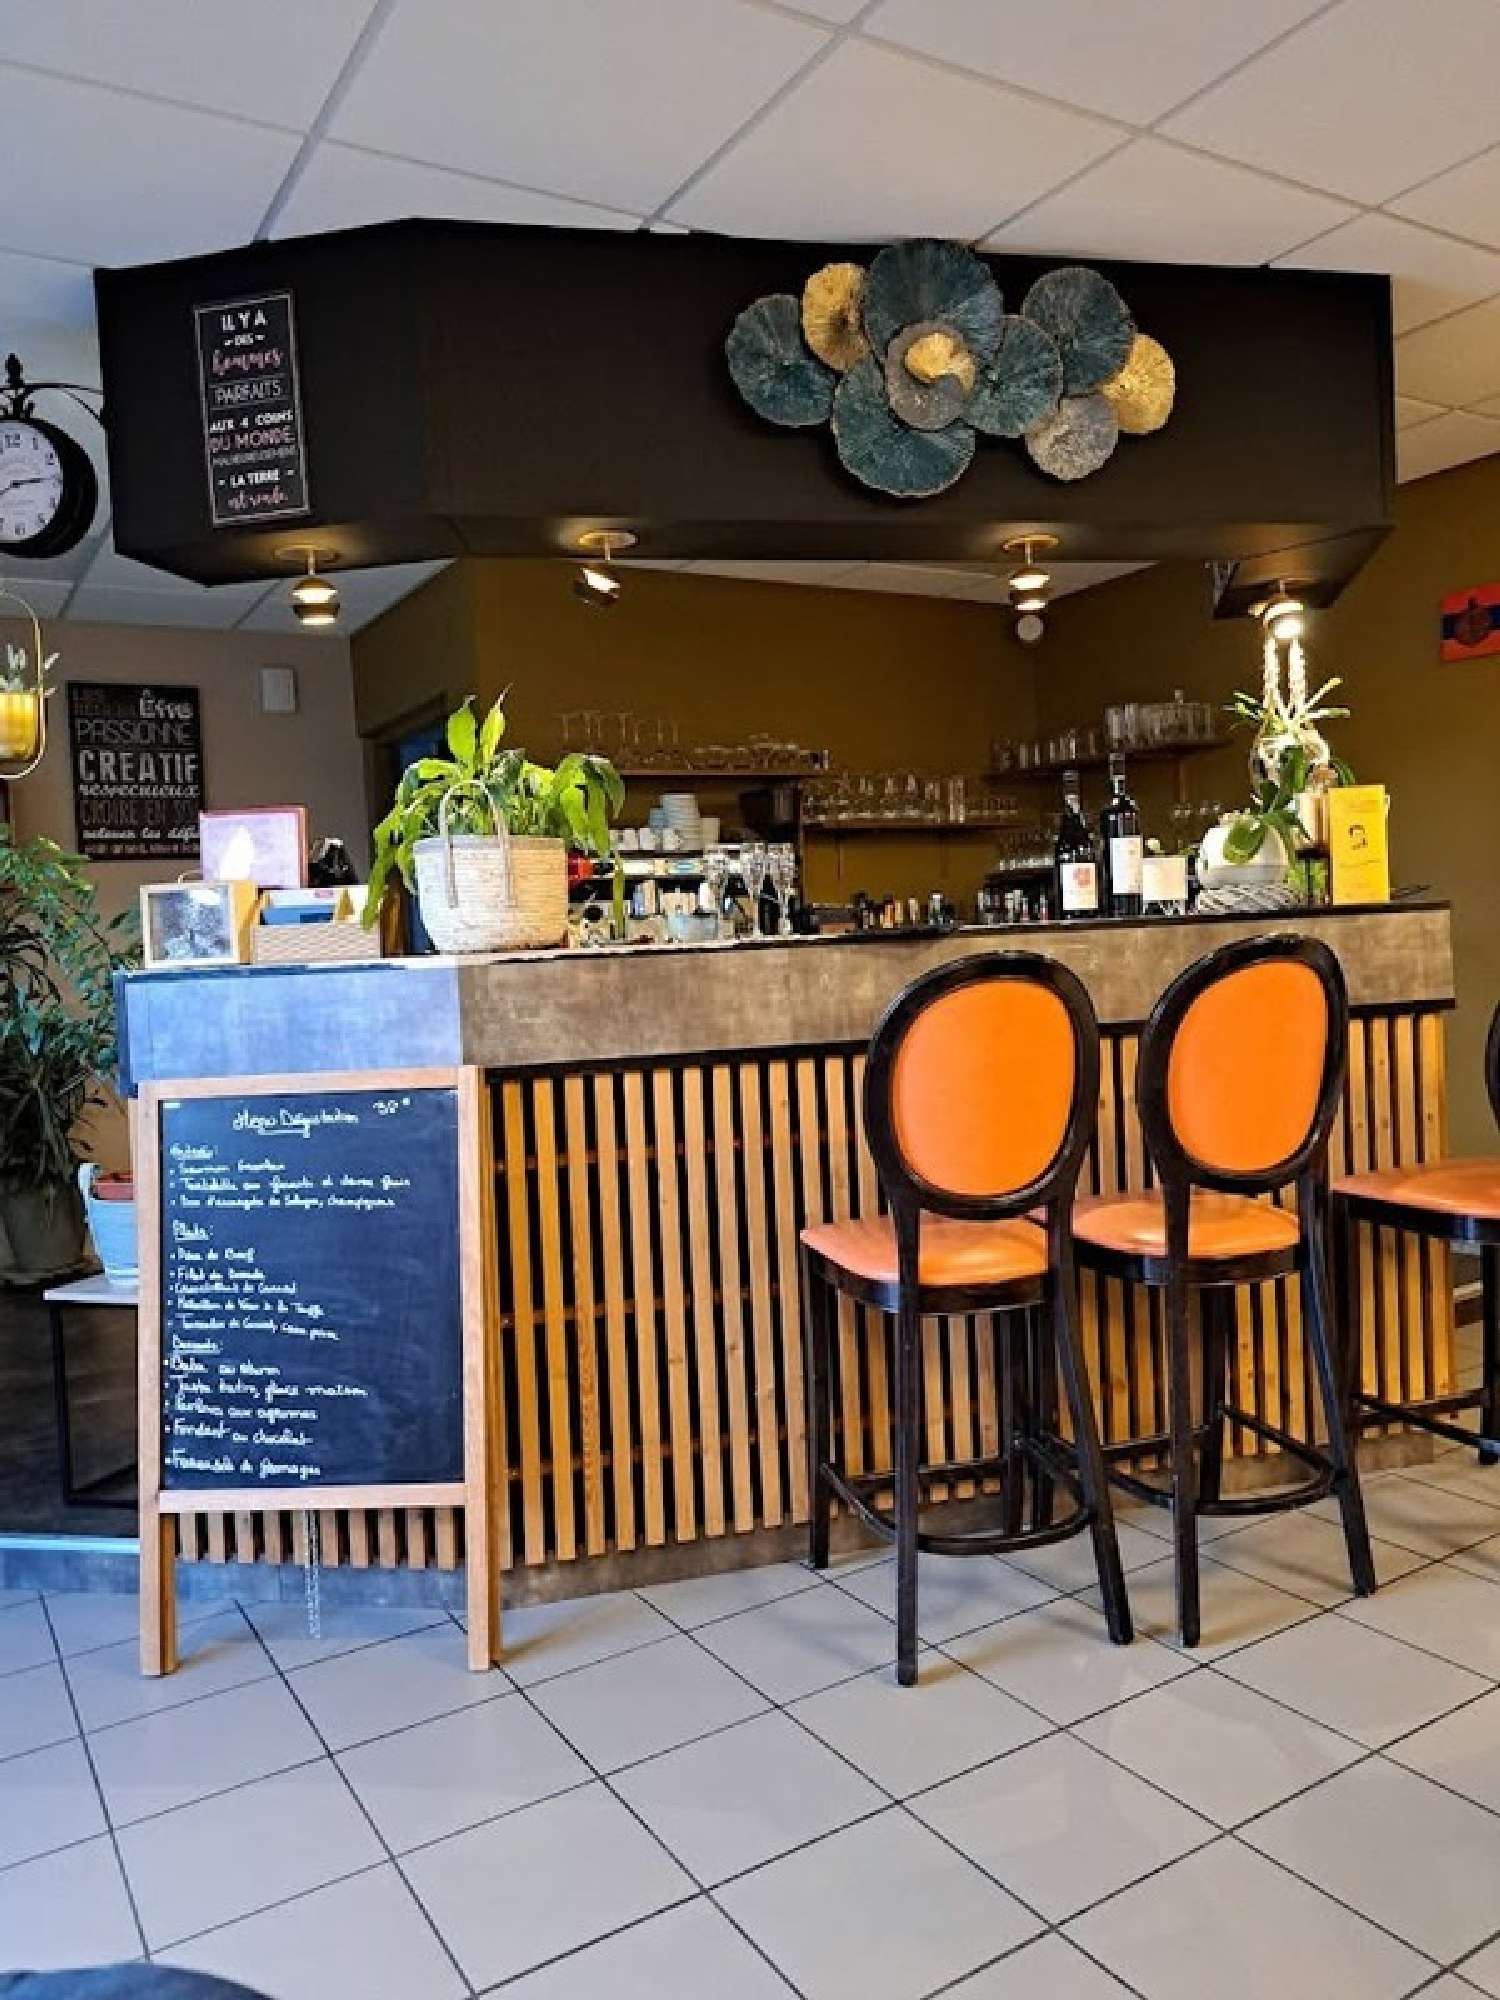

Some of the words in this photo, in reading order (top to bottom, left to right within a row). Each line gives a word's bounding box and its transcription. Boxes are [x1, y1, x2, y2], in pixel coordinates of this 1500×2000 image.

[239, 311, 249, 328] Y
[255, 309, 268, 325] A
[80, 749, 198, 783] CREATIF
